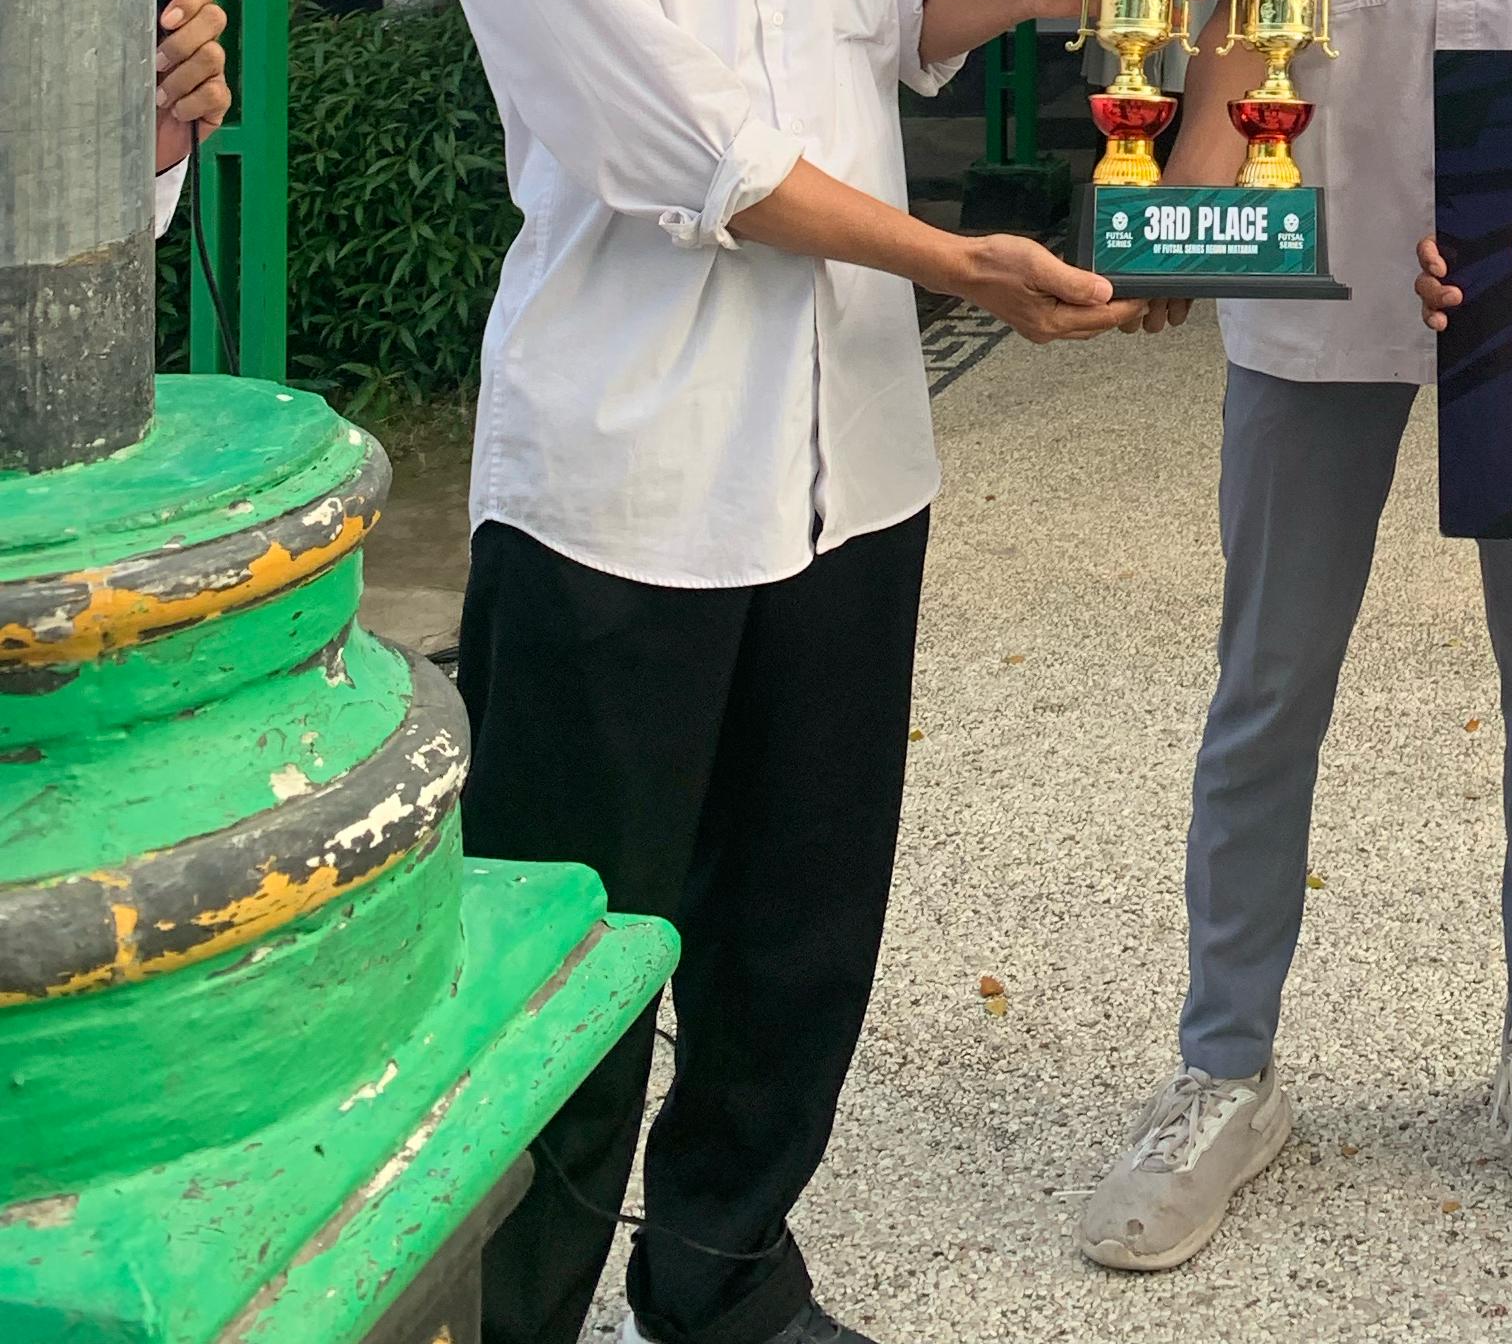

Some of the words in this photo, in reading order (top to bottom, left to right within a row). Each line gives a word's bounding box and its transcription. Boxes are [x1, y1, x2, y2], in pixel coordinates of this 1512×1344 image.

[1143, 205, 1191, 241] 3RD
[1197, 206, 1269, 242] PLACE
[1105, 231, 1134, 240] FUTSAL
[1277, 233, 1305, 242] FUTSAL
[1106, 239, 1132, 249] SERIES
[1279, 241, 1304, 250] SERIES
